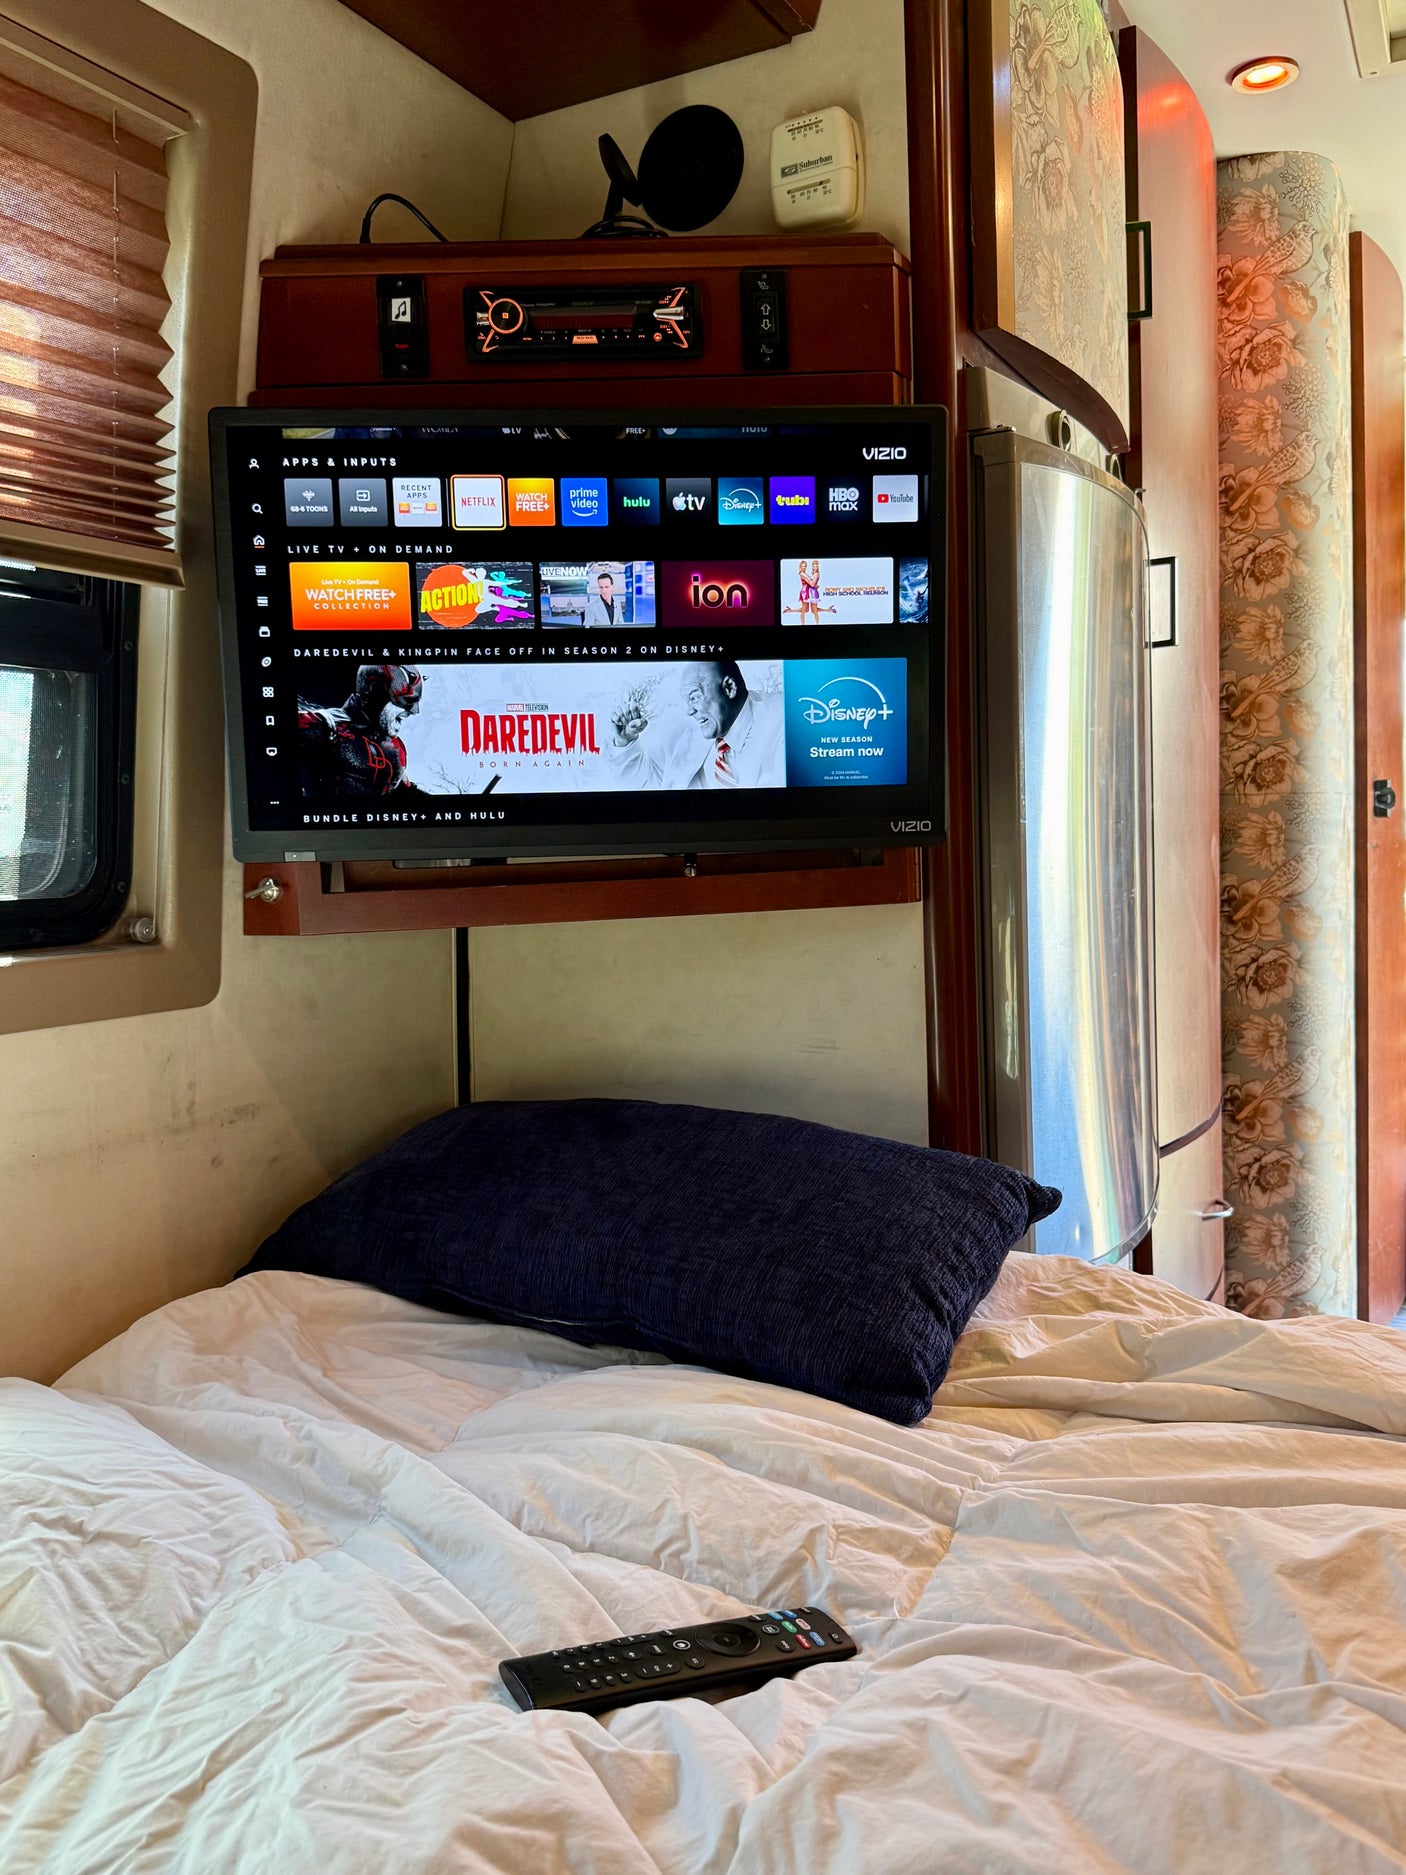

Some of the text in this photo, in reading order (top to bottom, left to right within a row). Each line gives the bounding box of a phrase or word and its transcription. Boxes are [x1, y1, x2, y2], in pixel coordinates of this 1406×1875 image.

[798, 155, 833, 170] Suburban
[862, 447, 907, 460] VIZIO
[282, 457, 397, 467] APPS & INPUTS
[515, 493, 548, 501] WATCH
[569, 487, 598, 499] prime
[829, 487, 859, 502] HBO
[890, 494, 914, 503] YouTube
[461, 497, 496, 507] NETFLIX
[570, 498, 599, 508] video
[623, 496, 651, 507] hulu
[720, 493, 762, 513] Disney+
[776, 494, 810, 506] tubi
[305, 505, 329, 513] TOONS
[349, 505, 378, 514] All Inputs
[516, 501, 550, 512] FREE+
[829, 501, 858, 511] max
[287, 545, 319, 554] LIVE
[328, 545, 344, 554] TV
[368, 545, 387, 554] ON
[395, 545, 453, 554] DEMAND
[691, 574, 749, 608] ion
[420, 581, 484, 613] ACTION!
[293, 645, 724, 657] DAREDEVIL & KINGPIN FACE OFF IN SEASON 2 ON DISNEY+
[798, 688, 894, 730] Disney+
[460, 709, 600, 756] DAREDEVIL
[809, 747, 884, 758] Stream now
[533, 759, 585, 768] AGAIN
[303, 811, 505, 823] BUNDLE DISNEY+ AND HULU
[890, 820, 932, 832] VIZIO
